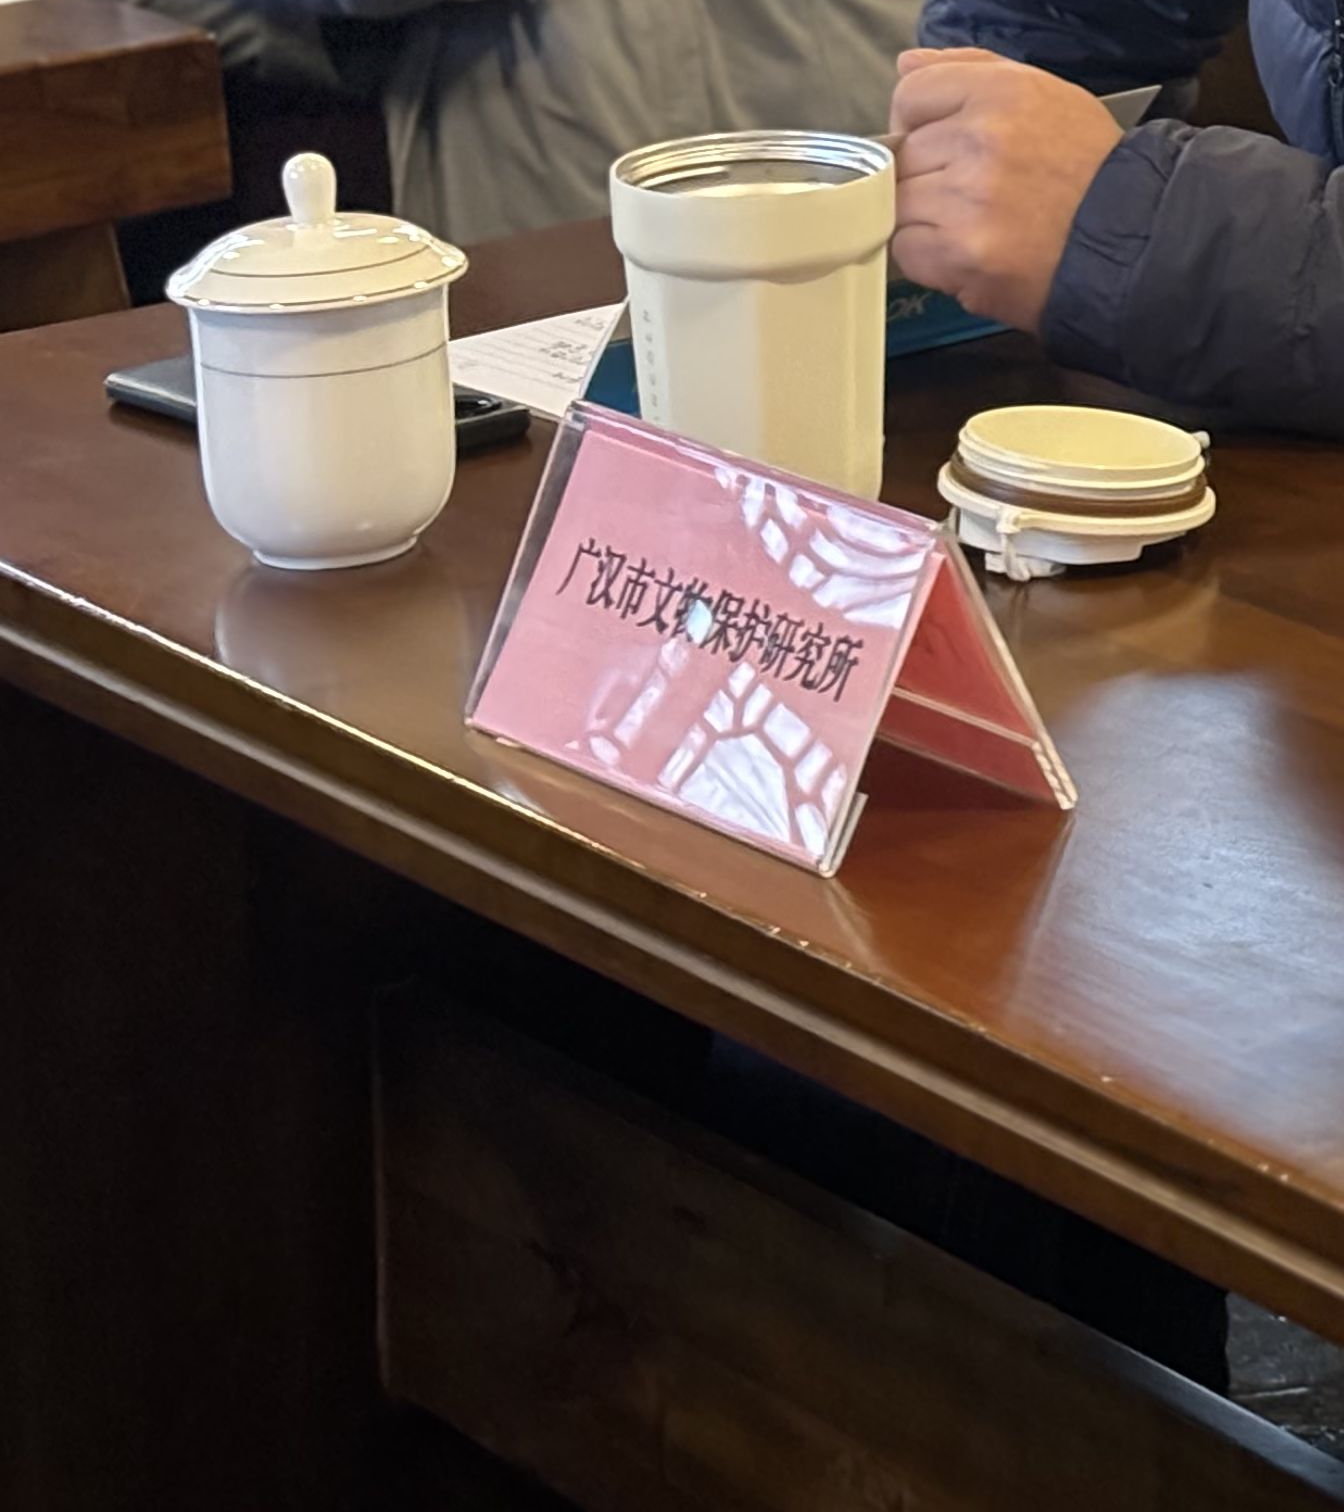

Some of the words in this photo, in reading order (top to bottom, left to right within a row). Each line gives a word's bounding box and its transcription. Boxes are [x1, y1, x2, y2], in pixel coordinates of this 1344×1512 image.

[555, 537, 864, 703] 广汉市文物保护研究所
